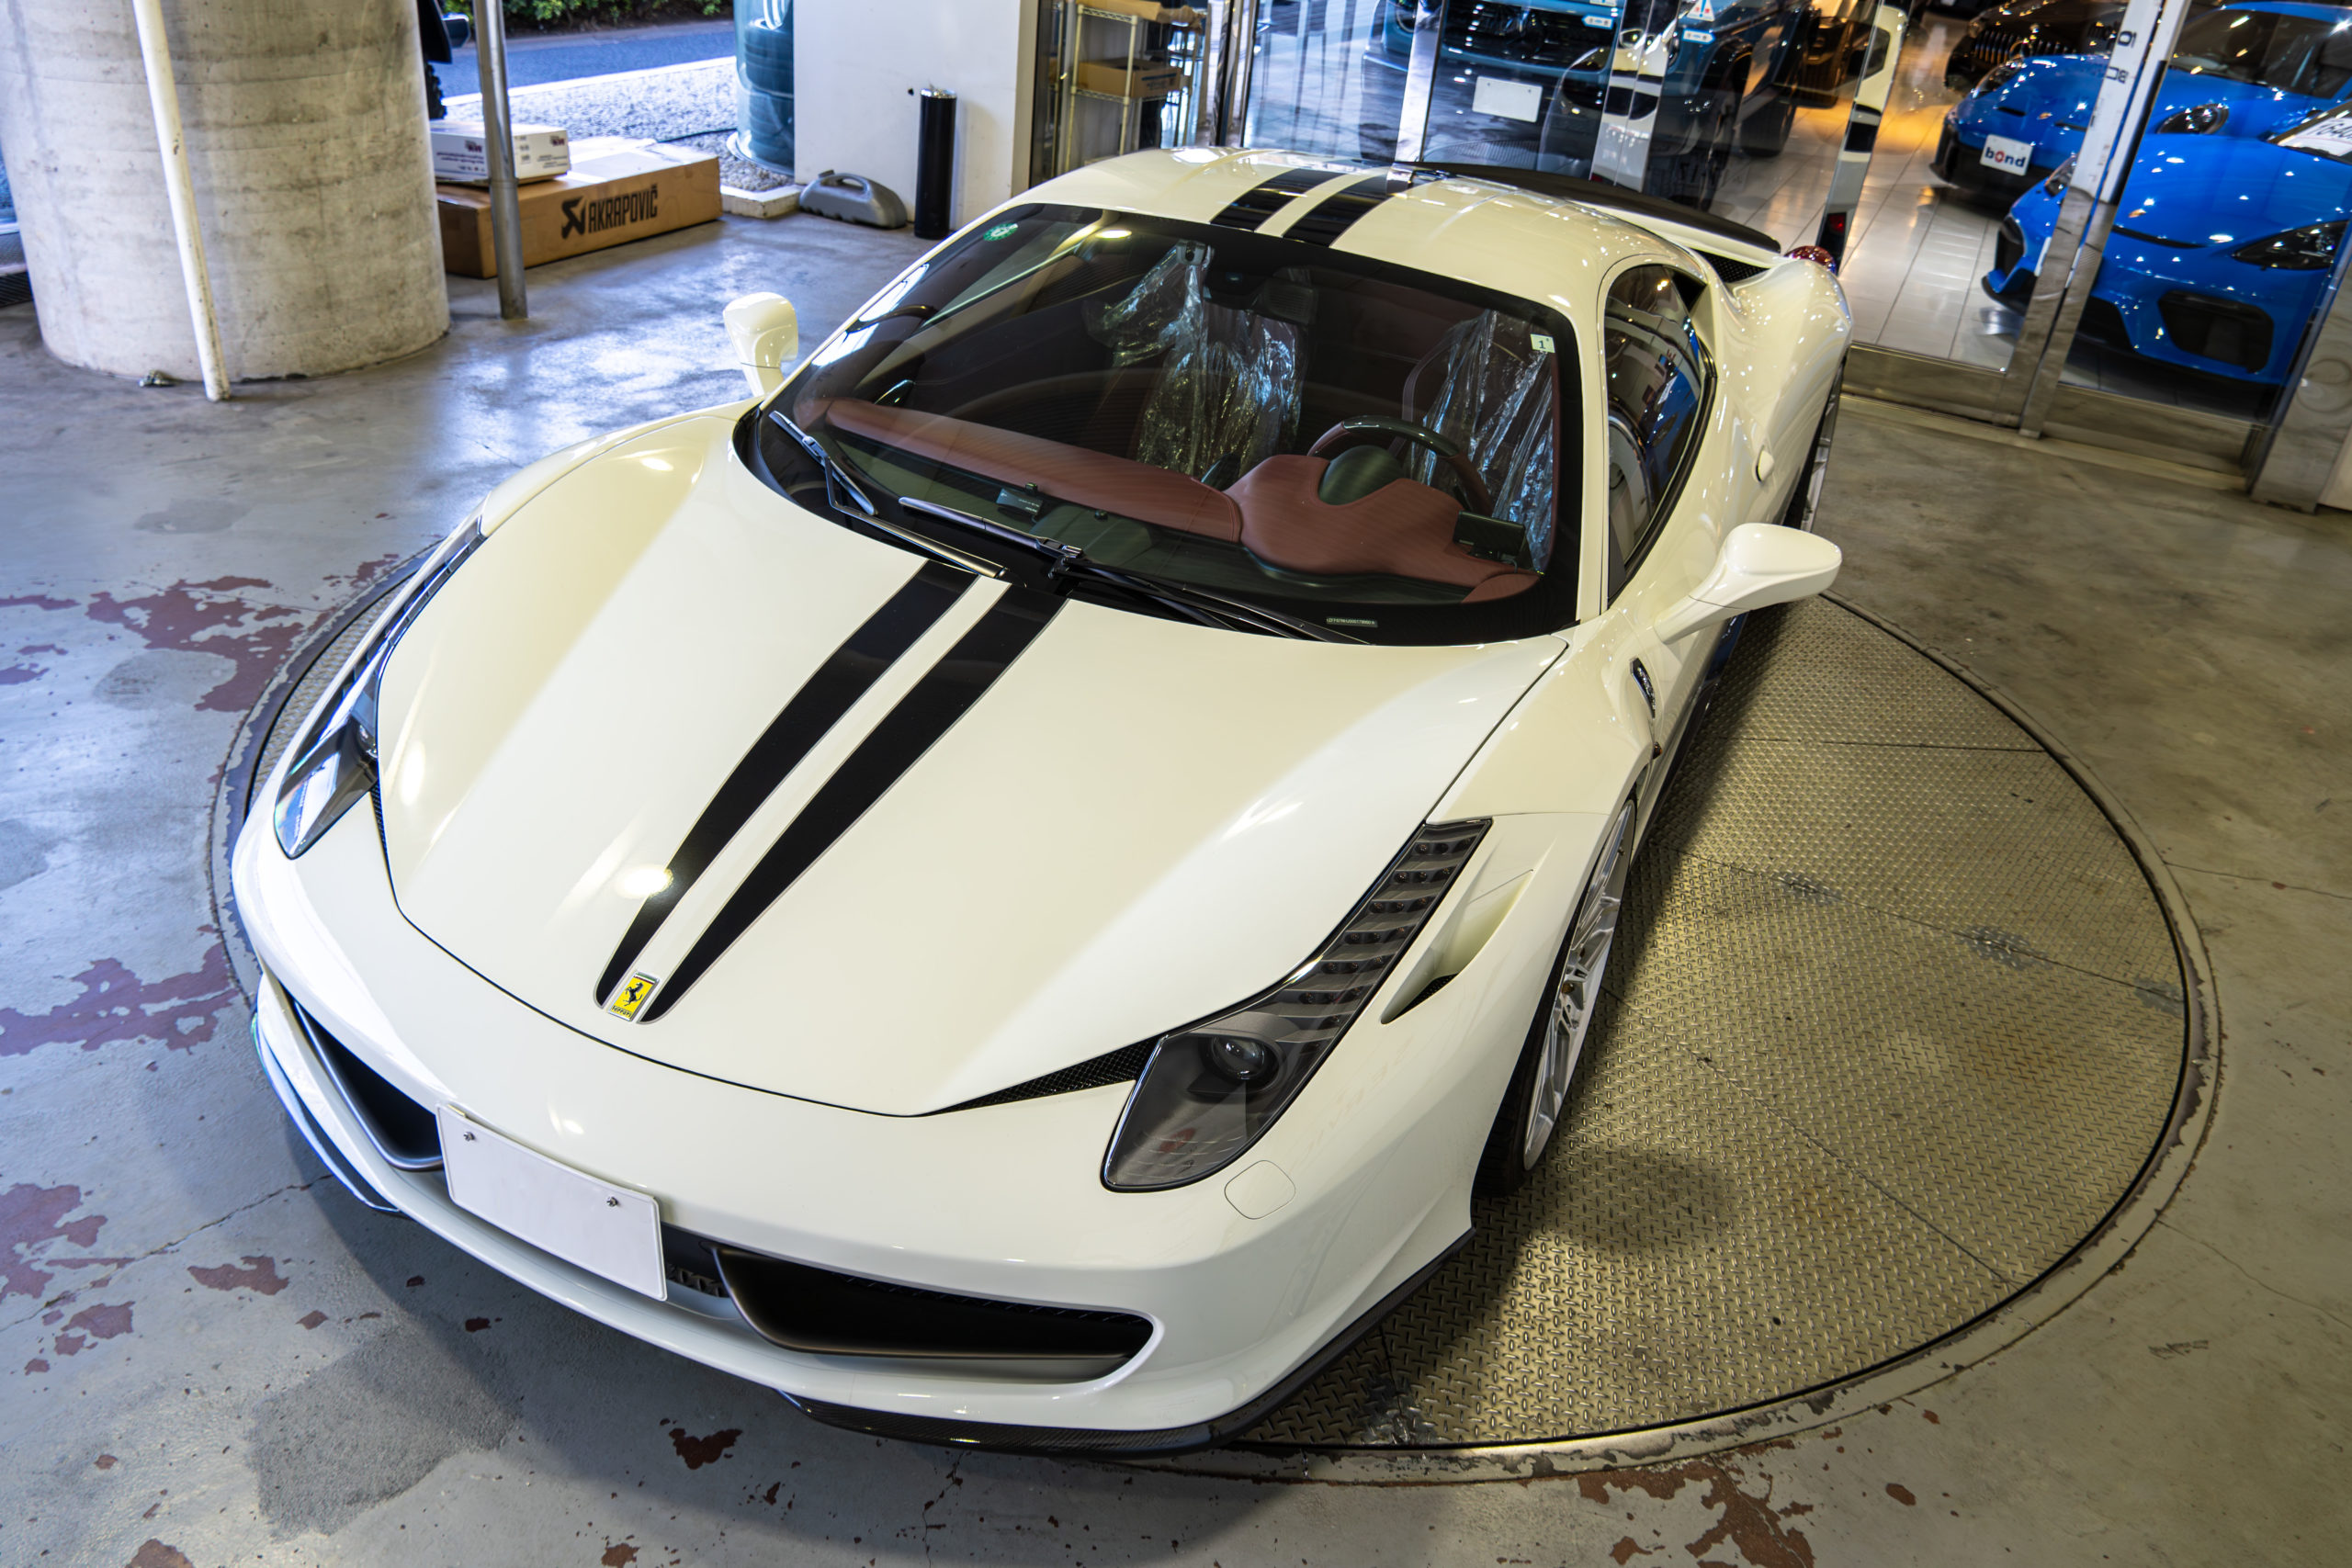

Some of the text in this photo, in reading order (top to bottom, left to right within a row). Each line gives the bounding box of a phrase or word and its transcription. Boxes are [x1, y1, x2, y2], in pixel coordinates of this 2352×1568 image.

[1984, 147, 2027, 168] bond
[587, 184, 658, 233] AKRAPOVIČ
[611, 1005, 632, 1018] Ferrari
